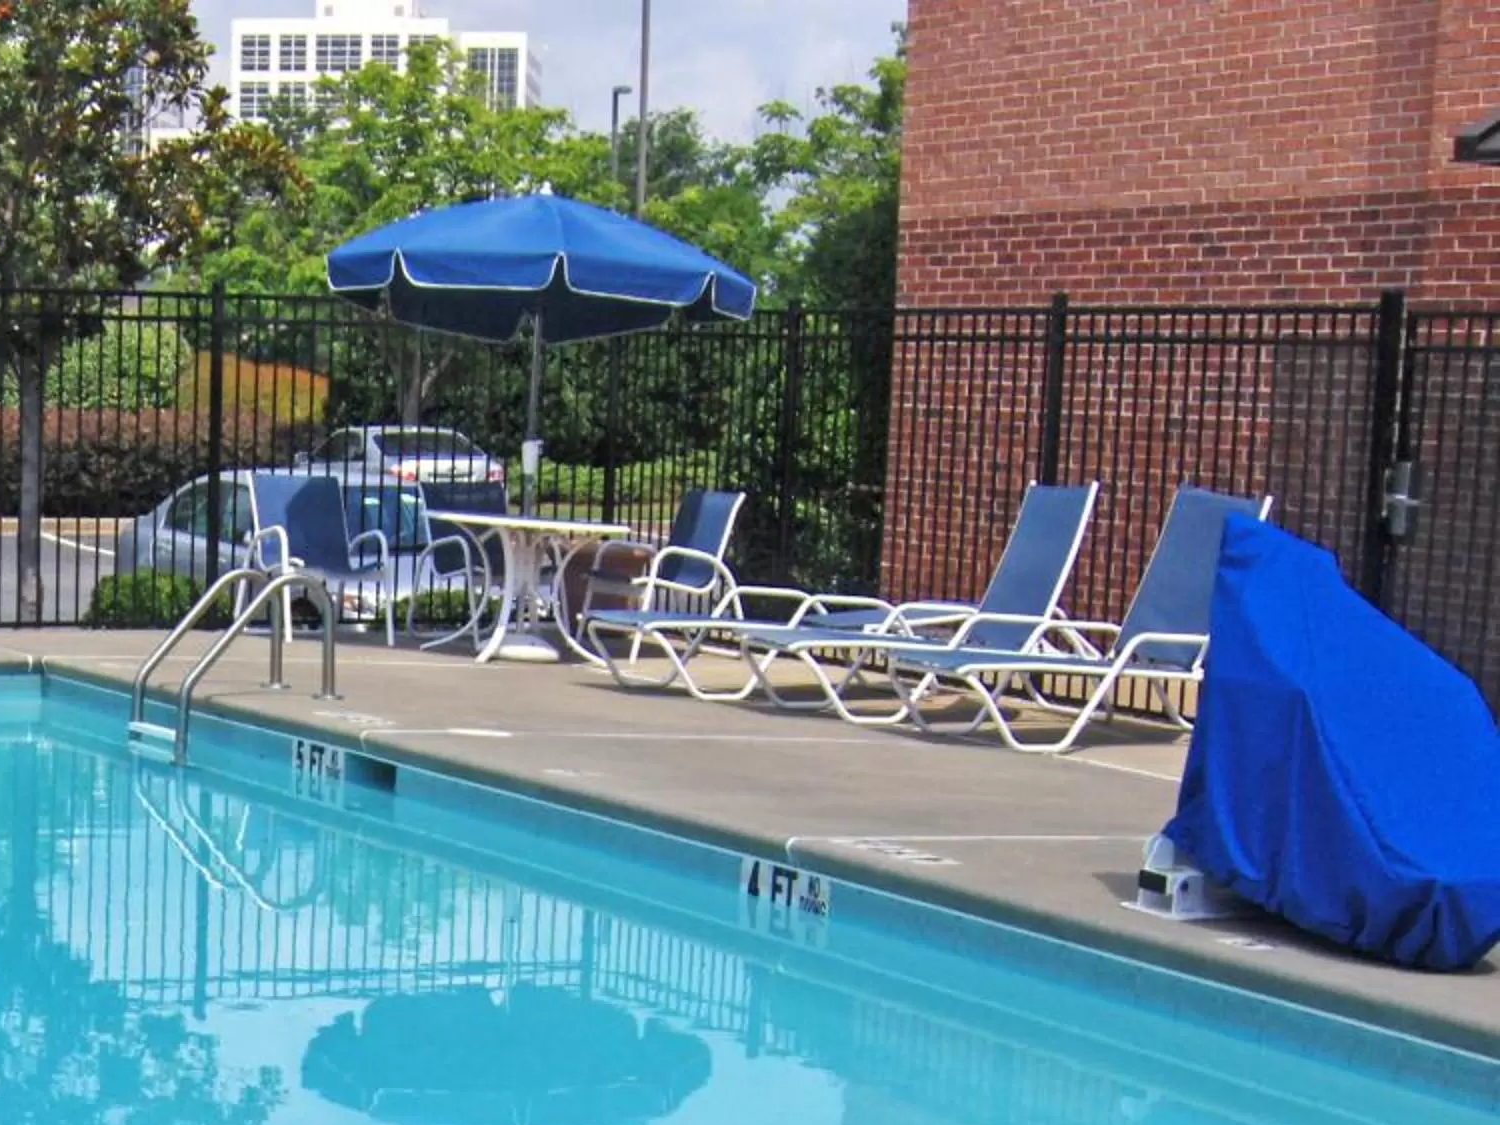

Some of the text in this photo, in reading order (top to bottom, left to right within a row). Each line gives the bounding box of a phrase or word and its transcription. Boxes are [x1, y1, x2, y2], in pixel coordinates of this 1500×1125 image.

[297, 740, 305, 769] 5
[309, 745, 325, 774] FT
[747, 860, 798, 907] 4 FT
